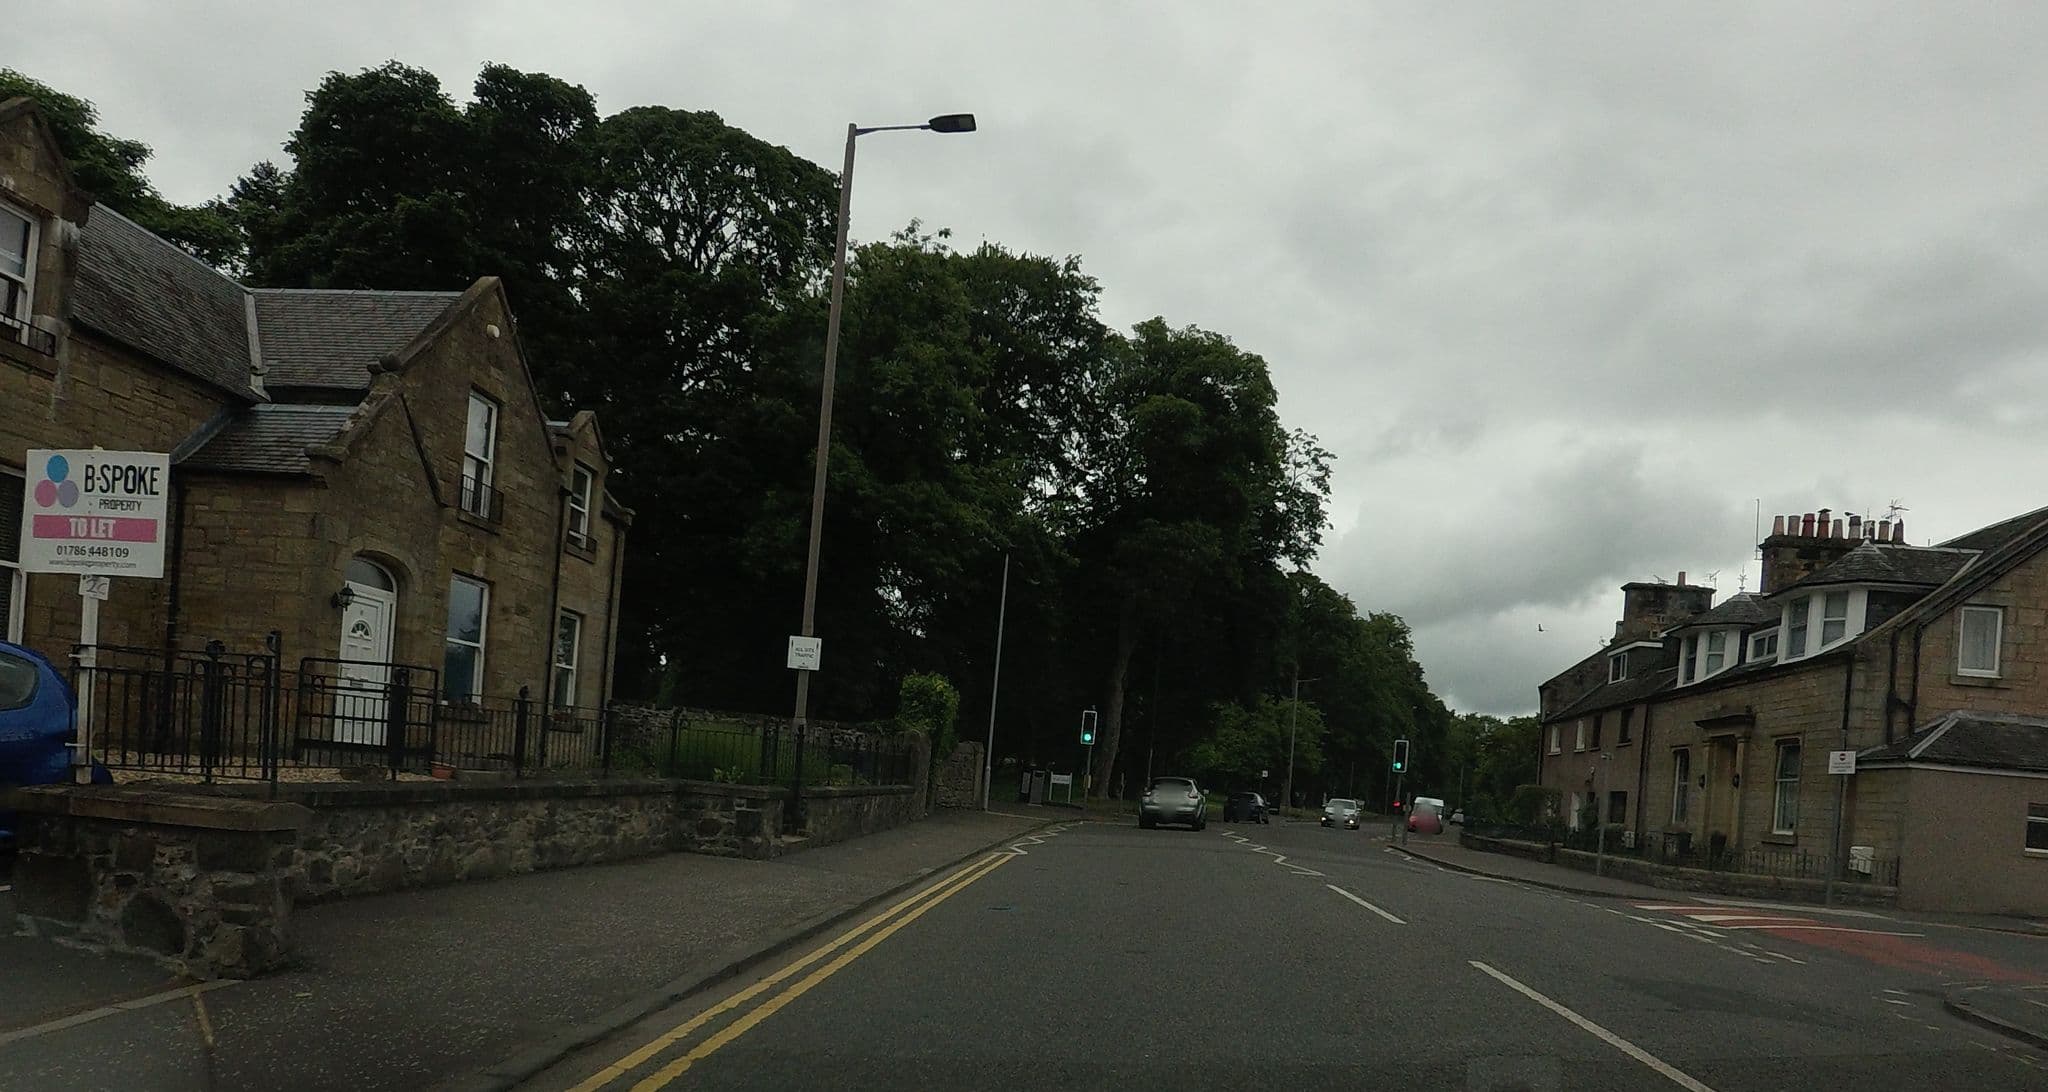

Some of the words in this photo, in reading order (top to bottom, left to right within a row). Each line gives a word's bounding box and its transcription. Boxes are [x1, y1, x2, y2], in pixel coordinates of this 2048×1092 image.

[84, 464, 160, 495] B-SPOKE
[98, 499, 142, 511] PROPERTY
[69, 518, 87, 537] TO
[90, 518, 116, 538] LET
[56, 545, 86, 556] 01786
[89, 546, 129, 558] 448109
